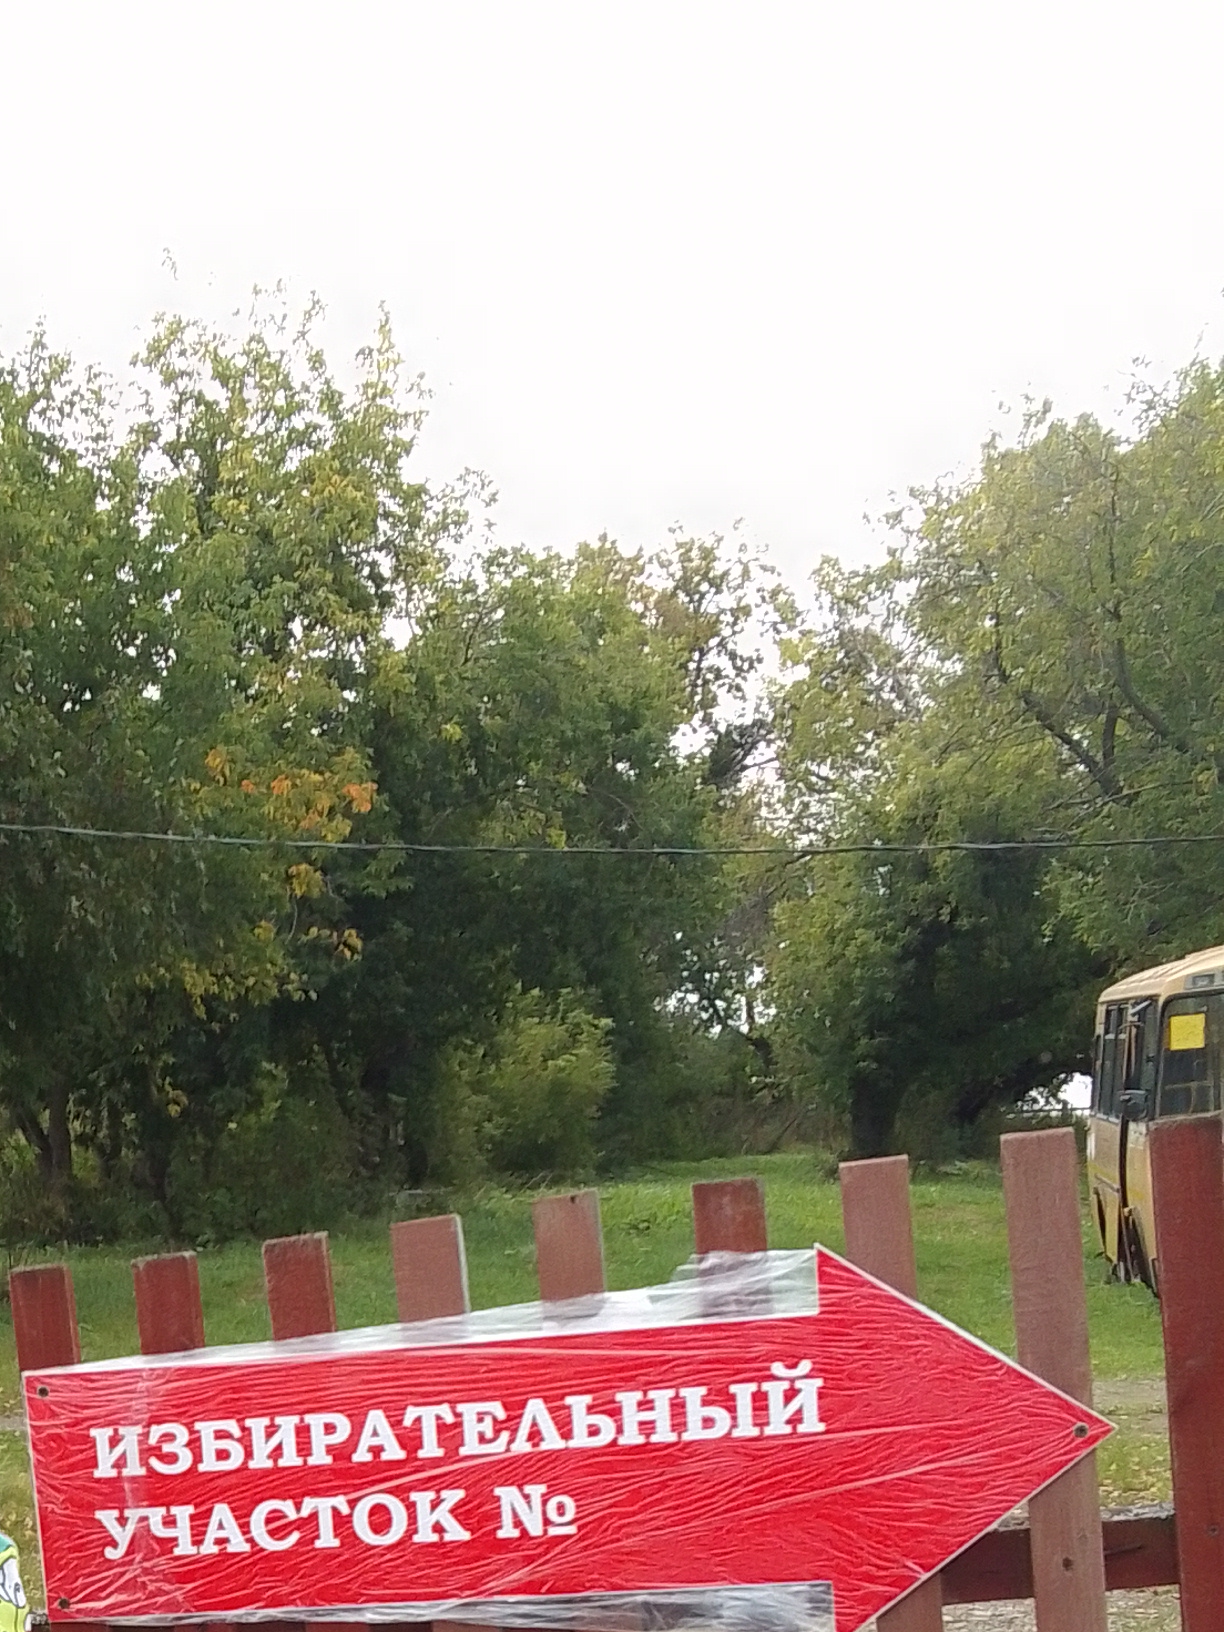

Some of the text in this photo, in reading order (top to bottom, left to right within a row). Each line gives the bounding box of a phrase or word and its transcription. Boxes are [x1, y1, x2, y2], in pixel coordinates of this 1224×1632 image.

[91, 1359, 826, 1478] ИЗБИРАТЕЛЬНЫЙ
[94, 1483, 578, 1560] УЧАСТОК №
